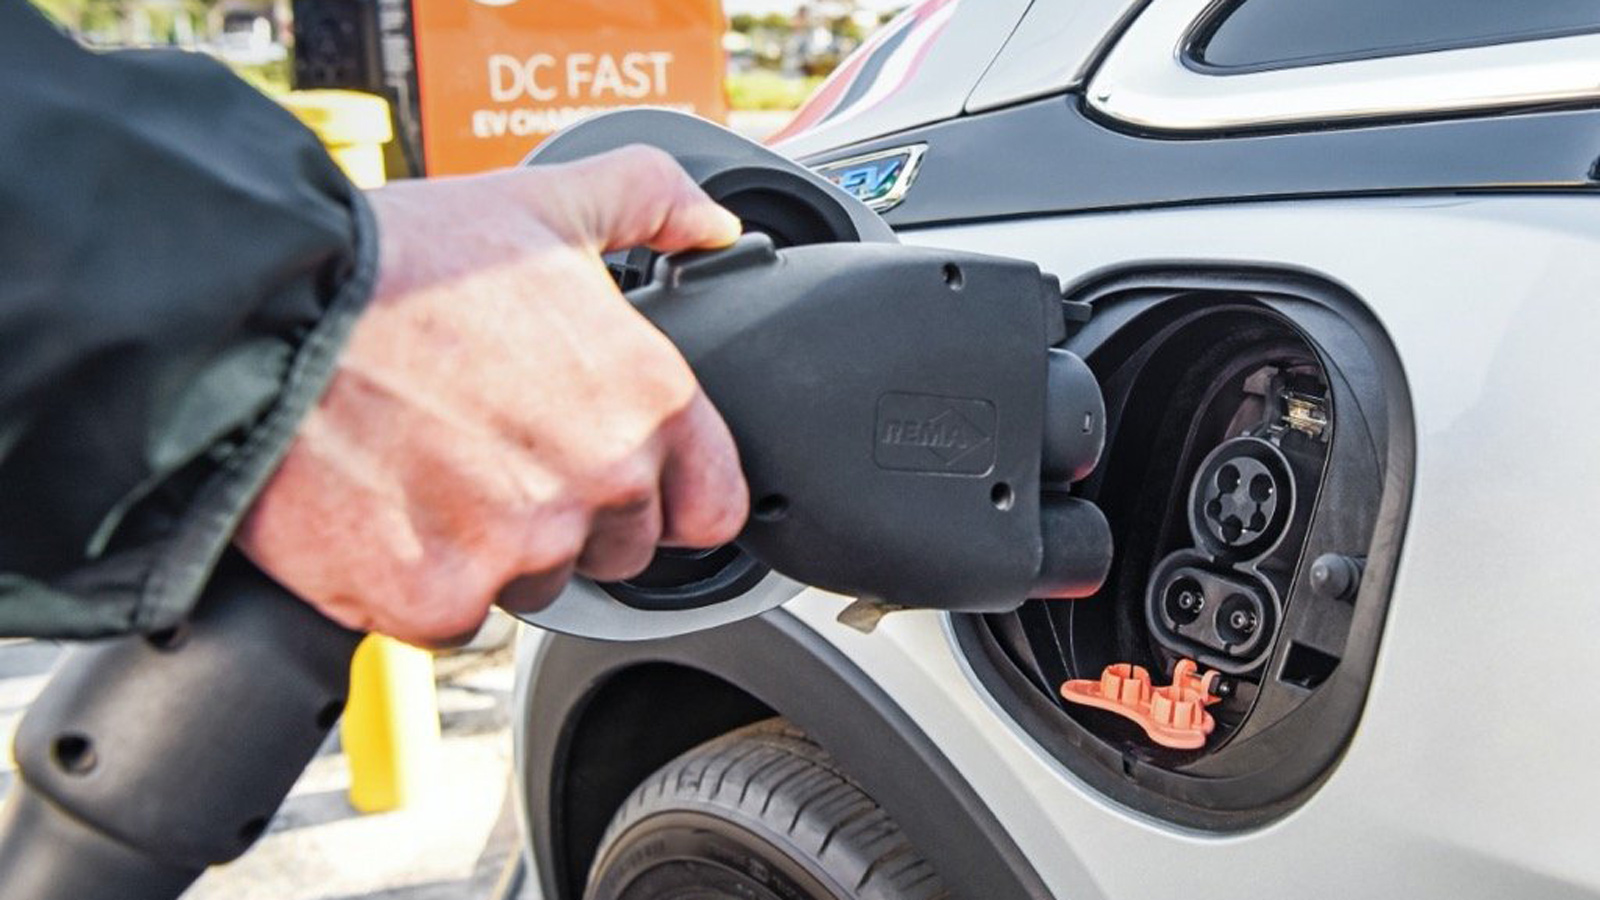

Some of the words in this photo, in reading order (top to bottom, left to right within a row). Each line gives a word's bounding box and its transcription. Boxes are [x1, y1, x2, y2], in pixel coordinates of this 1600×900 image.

[488, 53, 557, 102] DC
[566, 51, 673, 98] FAST
[473, 109, 506, 138] EV
[881, 418, 968, 449] REMA
